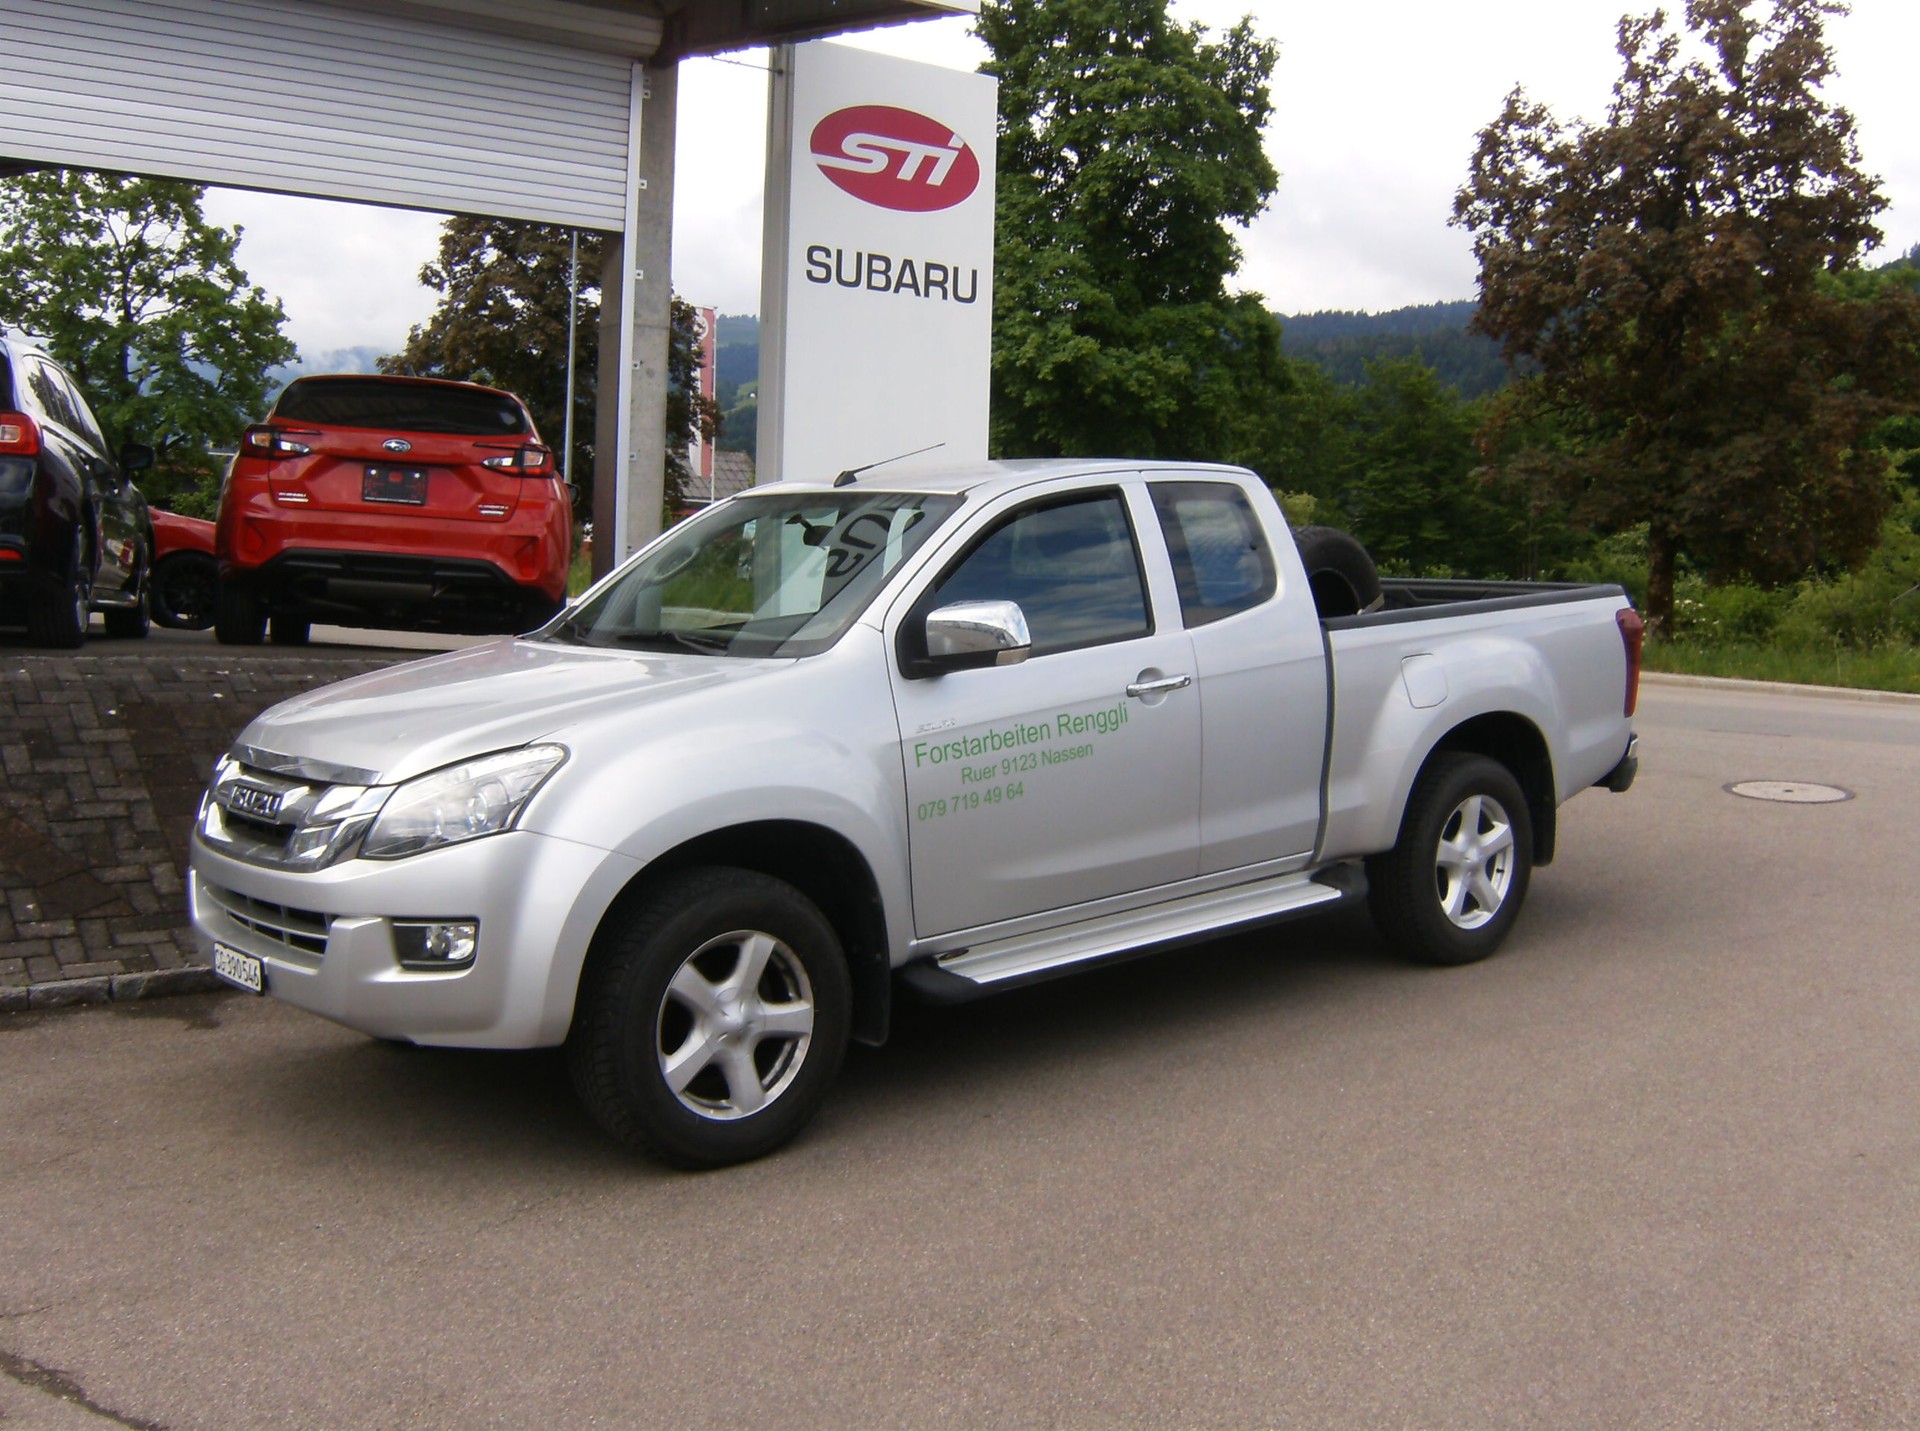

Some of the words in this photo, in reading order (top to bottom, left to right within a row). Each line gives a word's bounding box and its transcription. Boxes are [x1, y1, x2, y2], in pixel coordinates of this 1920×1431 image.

[806, 245, 978, 304] SUBARU
[914, 723, 1051, 768] Forstarbeiten
[1057, 702, 1129, 737] Renggli
[961, 764, 997, 784] Ruer
[1001, 752, 1038, 776] 9123
[1041, 744, 1093, 766] Nassen
[230, 785, 280, 816] ISUZU
[918, 799, 947, 821] 079
[952, 790, 979, 812] 719
[983, 786, 1002, 804] 49
[1006, 781, 1024, 800] 64
